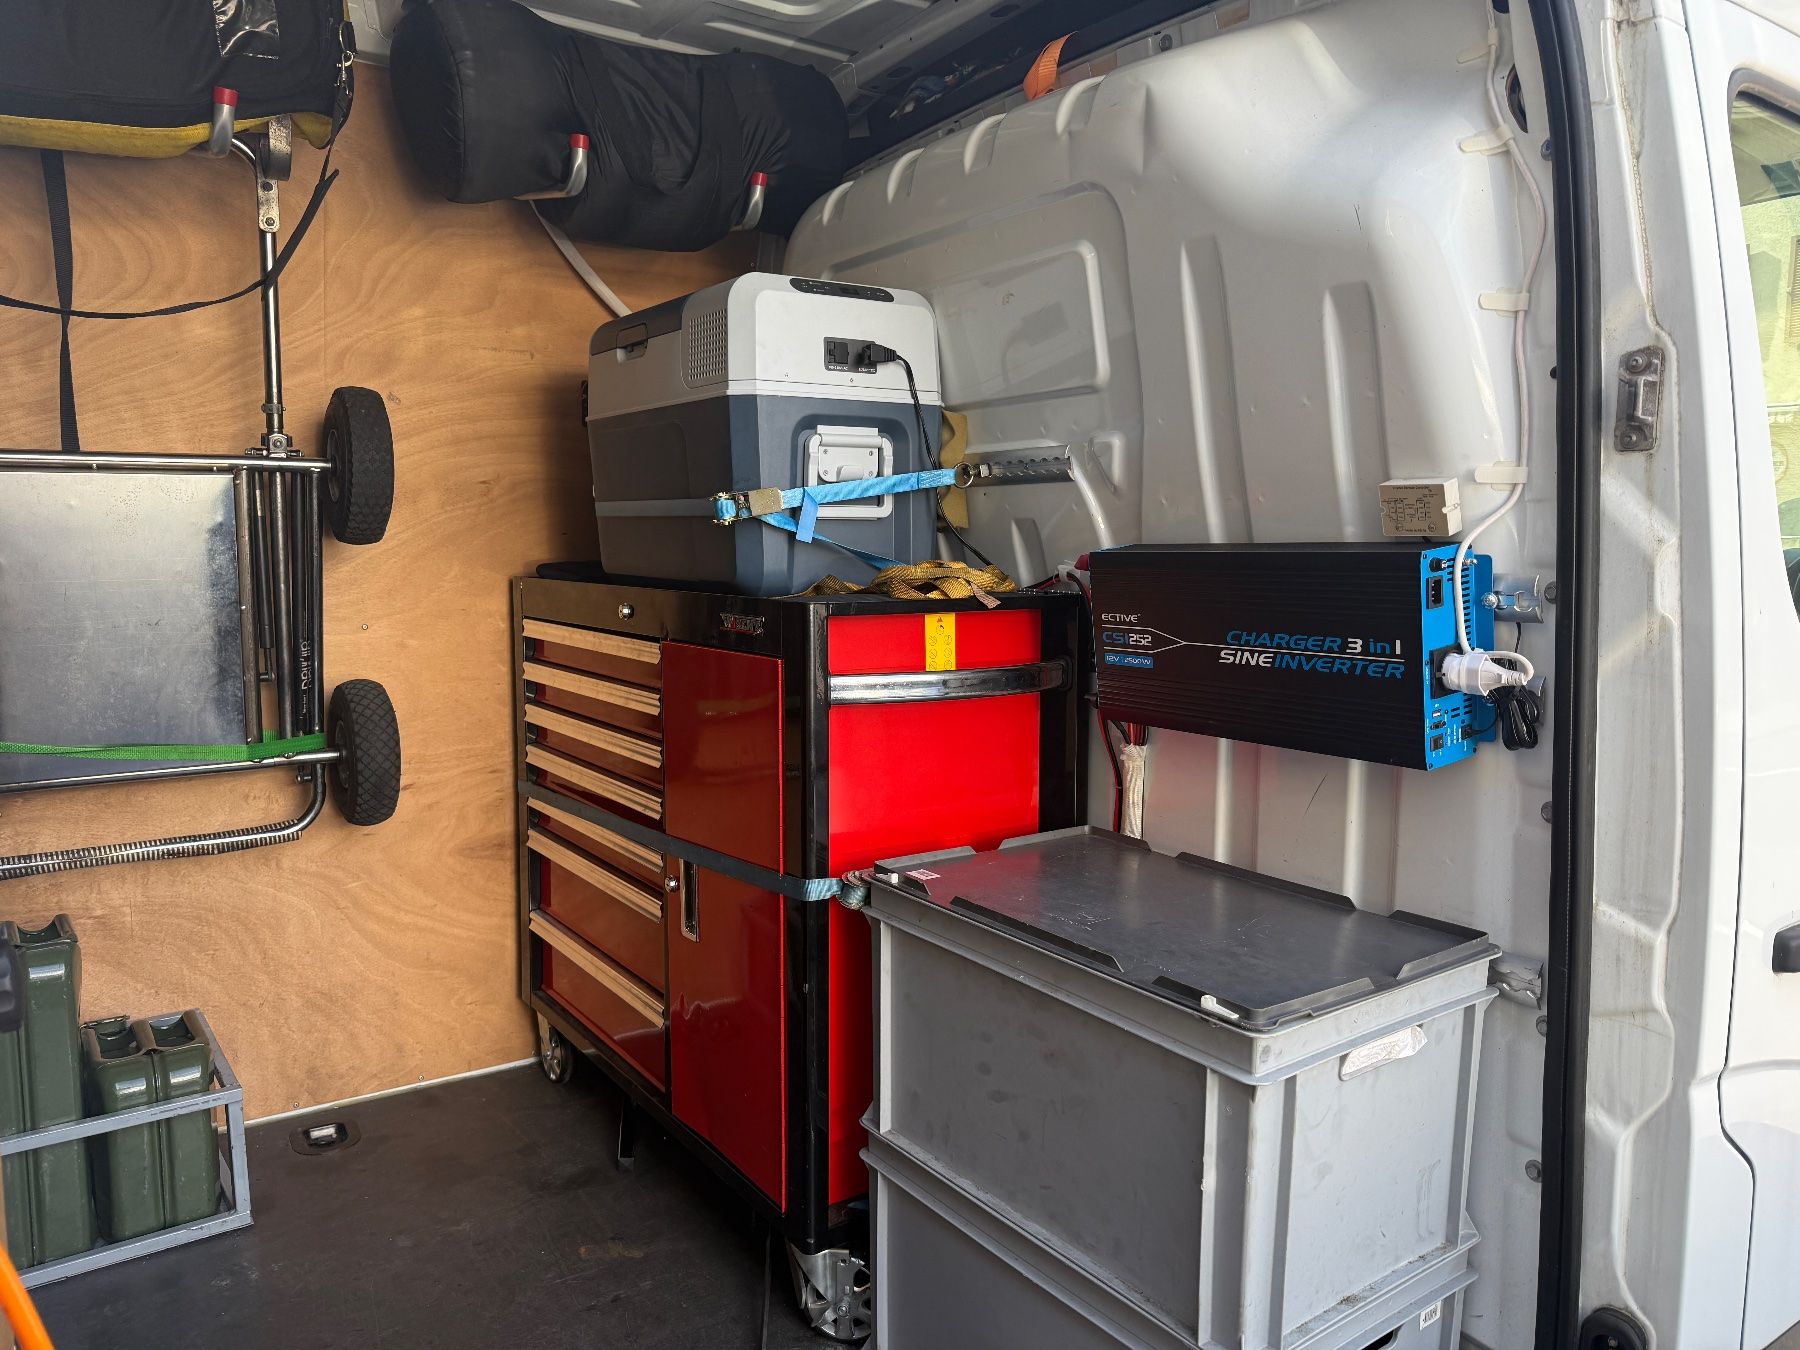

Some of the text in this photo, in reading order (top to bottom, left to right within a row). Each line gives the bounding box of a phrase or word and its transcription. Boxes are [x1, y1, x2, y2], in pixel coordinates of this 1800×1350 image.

[1226, 630, 1342, 652] CHARGER
[1345, 637, 1363, 653] 3
[1369, 638, 1391, 654] in
